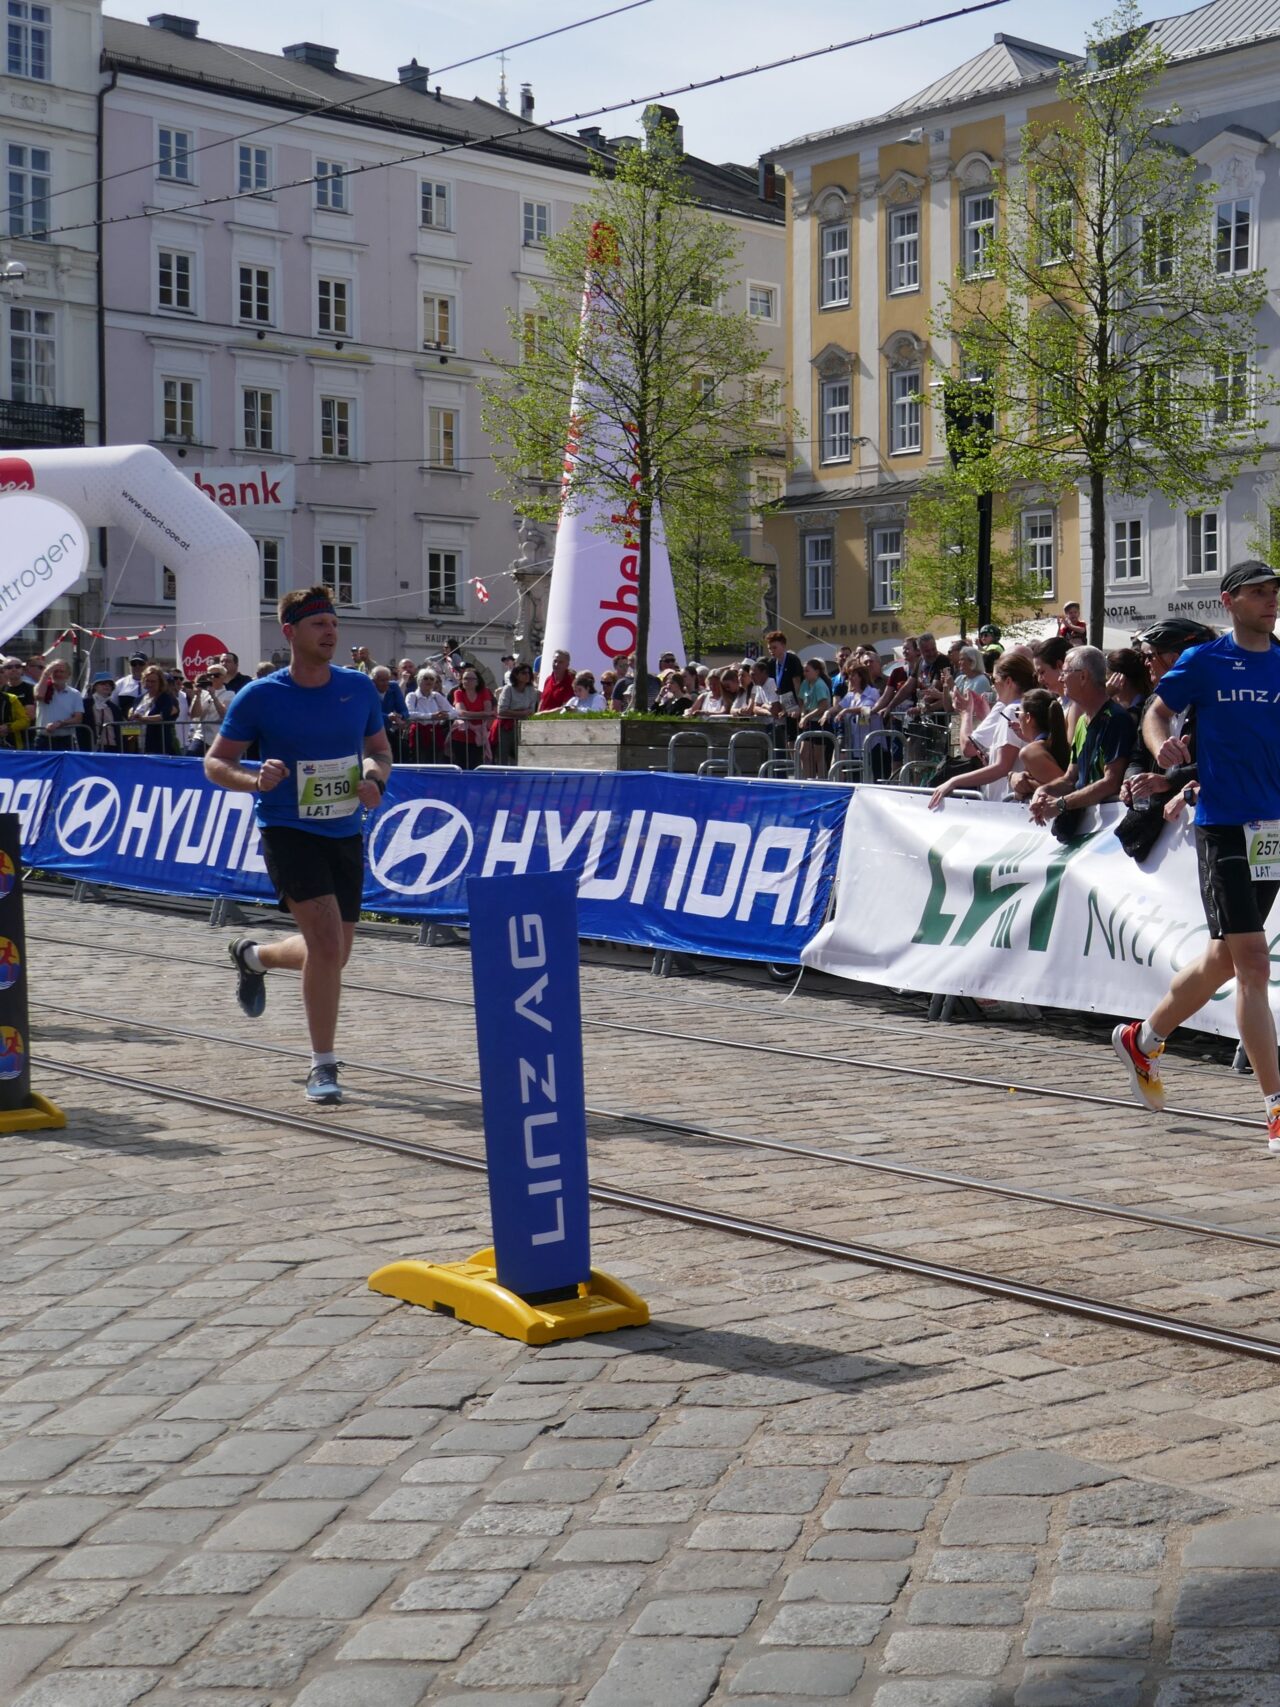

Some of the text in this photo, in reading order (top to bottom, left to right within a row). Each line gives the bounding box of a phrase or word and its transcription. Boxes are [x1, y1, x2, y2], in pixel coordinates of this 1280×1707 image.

[121, 490, 191, 551] www.sport-ooe.at
[0, 532, 78, 612] itrogen
[1103, 605, 1137, 618] NOTAR
[1167, 601, 1194, 612] BANK
[1217, 689, 1269, 703] LINZ
[313, 780, 350, 798] 5150
[481, 809, 833, 927] HYUNDAI
[508, 912, 566, 1247] LINZ AG
